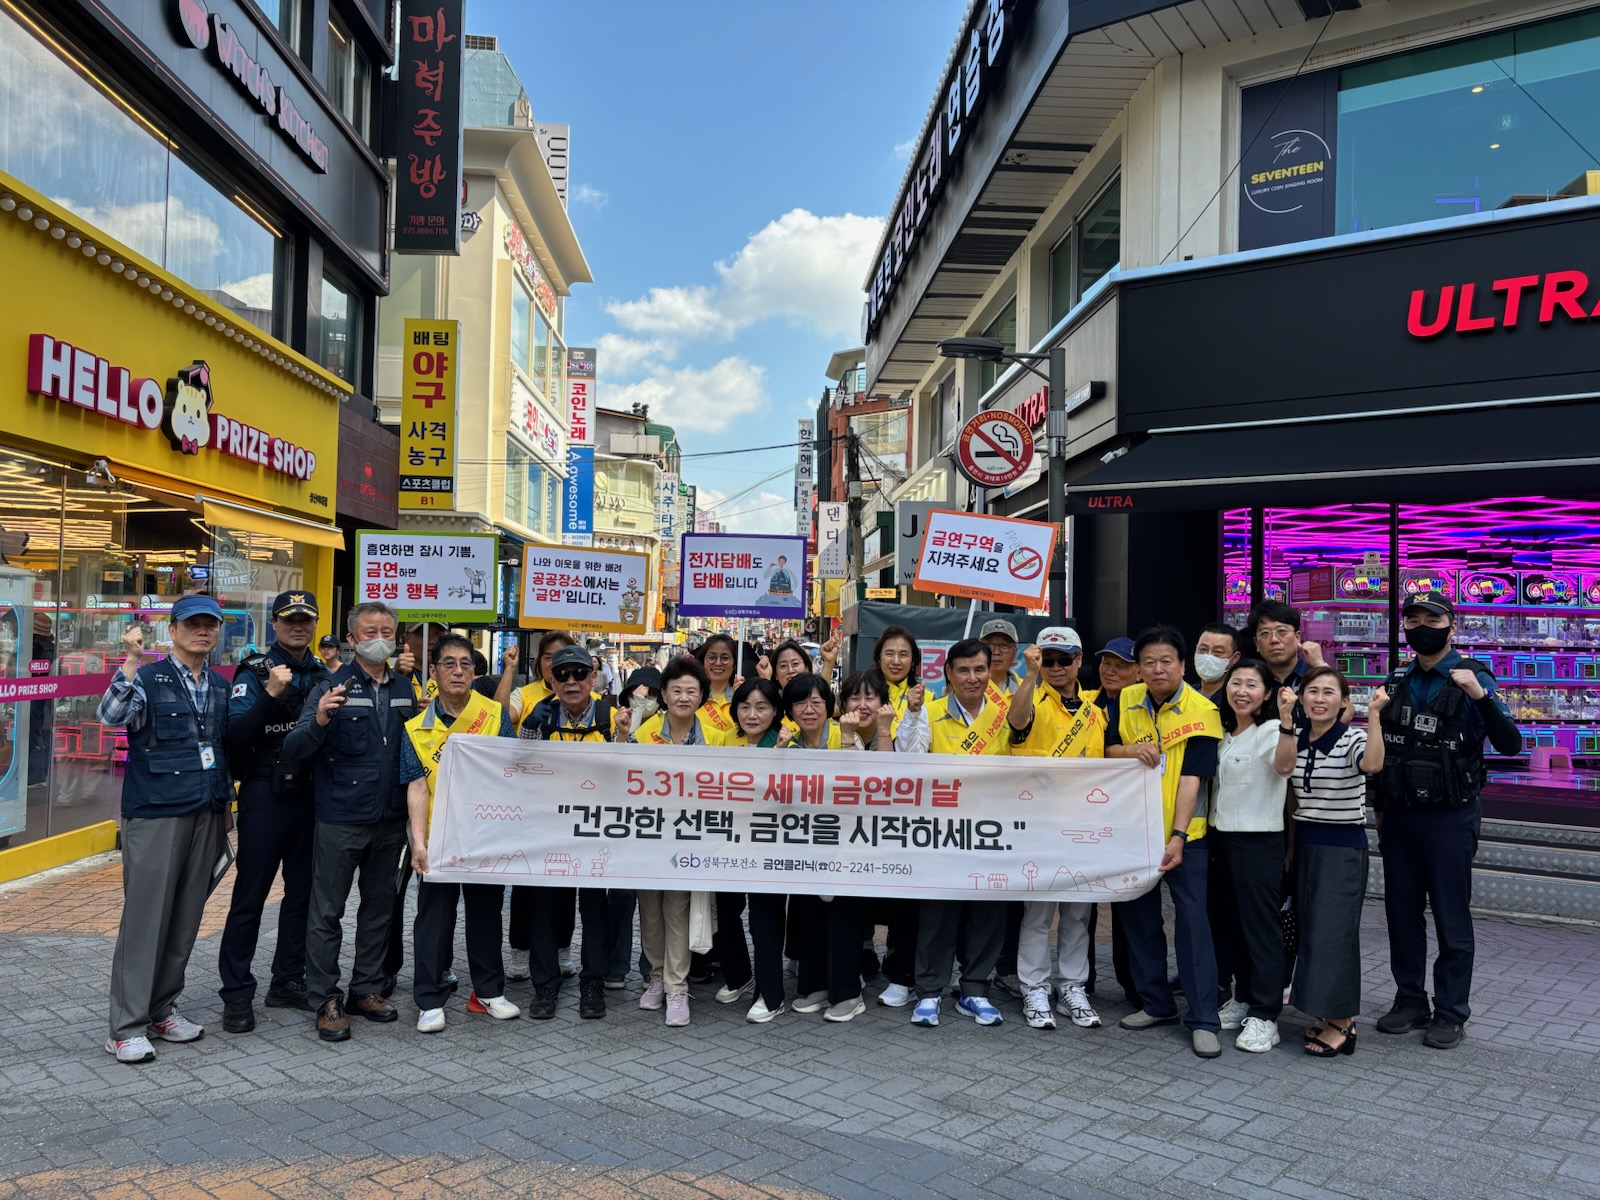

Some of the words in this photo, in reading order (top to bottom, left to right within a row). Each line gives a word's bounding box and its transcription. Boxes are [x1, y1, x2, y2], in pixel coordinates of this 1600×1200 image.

[1273, 136, 1302, 164] The
[1251, 160, 1324, 185] SEVENTEEN
[1251, 187, 1270, 196] LUXURY
[1271, 184, 1284, 192] COIN
[1284, 180, 1306, 190] SINGING
[1306, 176, 1324, 185] ROOM
[1407, 269, 1600, 337] ULTR
[413, 331, 449, 346] 배팅
[29, 333, 164, 430] HELLO
[412, 351, 449, 408] 야구
[570, 382, 587, 441] 코인노래
[1013, 385, 1048, 428] LTRA
[407, 421, 446, 440] 사격
[213, 414, 270, 467] PRIZE
[272, 436, 317, 481] SHOP
[407, 446, 446, 466] 농구
[401, 478, 451, 490] 스포츠클럽
[420, 496, 435, 505] B1
[1088, 495, 1134, 508] ULTRA
[826, 506, 841, 545] 댄디
[366, 543, 414, 557] 흡연하면
[419, 545, 443, 557] 잠시
[448, 545, 475, 558] 기쁨,
[931, 530, 1004, 554] 금연구역을
[366, 561, 417, 578] 금연하면
[533, 557, 551, 567] 나와
[554, 558, 581, 570] 이웃을
[584, 561, 602, 573] 위한
[605, 563, 622, 573] 배려
[688, 552, 763, 569] 전자담배도
[927, 550, 1000, 574] 지켜주세요
[532, 571, 621, 591] 공공장소에서는
[693, 572, 758, 589] 담배입니다
[366, 582, 398, 599] 평생
[406, 583, 438, 600] 행복
[31, 663, 49, 671] HELLO
[18, 683, 38, 696] PRIZE
[38, 681, 58, 693] SHOP
[265, 720, 298, 734] POLIC
[626, 769, 756, 802] 5.31.일은
[762, 772, 825, 806] 세계
[832, 775, 921, 807] 금연의
[931, 778, 962, 808] 날
[672, 808, 742, 844] 선택,
[748, 811, 842, 846] 금연을
[702, 856, 758, 870] 성북구보건소
